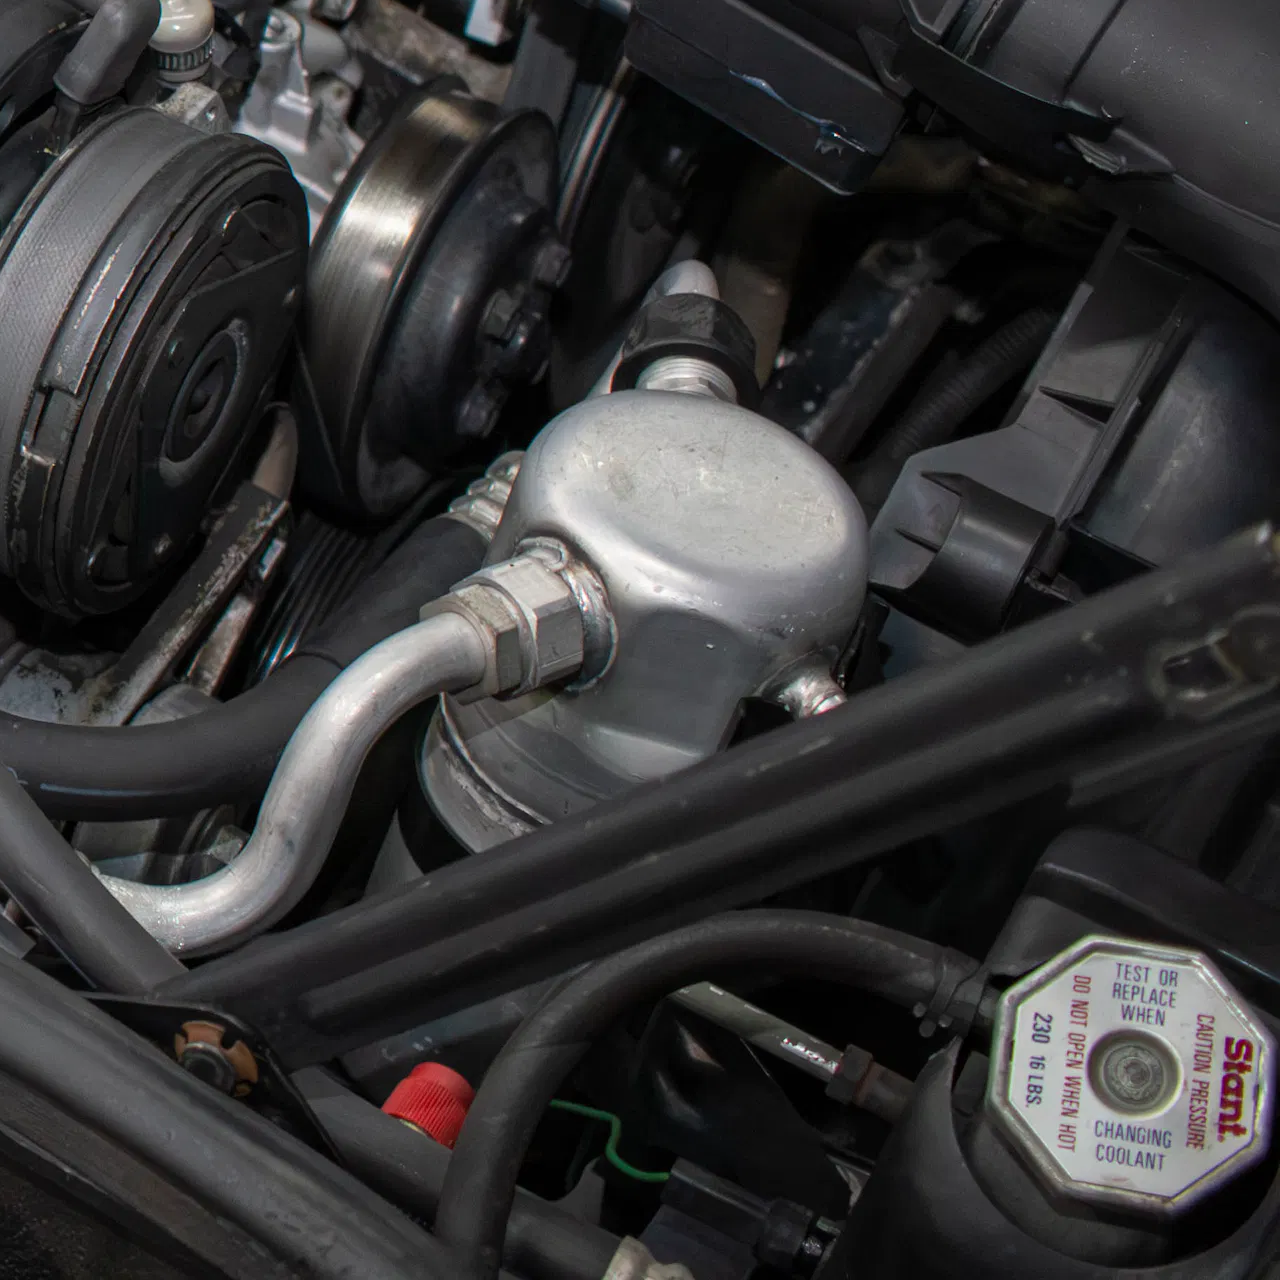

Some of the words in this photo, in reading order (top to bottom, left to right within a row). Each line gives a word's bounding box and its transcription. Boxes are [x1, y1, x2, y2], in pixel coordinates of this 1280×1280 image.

[1072, 975, 1091, 994] DO
[1116, 962, 1152, 983] TEST
[1159, 969, 1179, 988] OR
[1112, 983, 1177, 1009] REPLACE
[1031, 1012, 1053, 1044] 230
[1070, 1001, 1090, 1027] NOT
[1120, 1005, 1166, 1027] WHEN
[1065, 1032, 1087, 1070] OPEN
[1193, 1013, 1215, 1072] CAUTION
[1030, 1056, 1046, 1070] 16
[1025, 1075, 1044, 1109] LBS.
[1060, 1076, 1083, 1118] WHEN
[1186, 1079, 1210, 1150] PRESSURE
[1057, 1123, 1077, 1152] HOT
[1094, 1120, 1172, 1149] CHANGING
[1096, 1144, 1166, 1171] COOLANT
